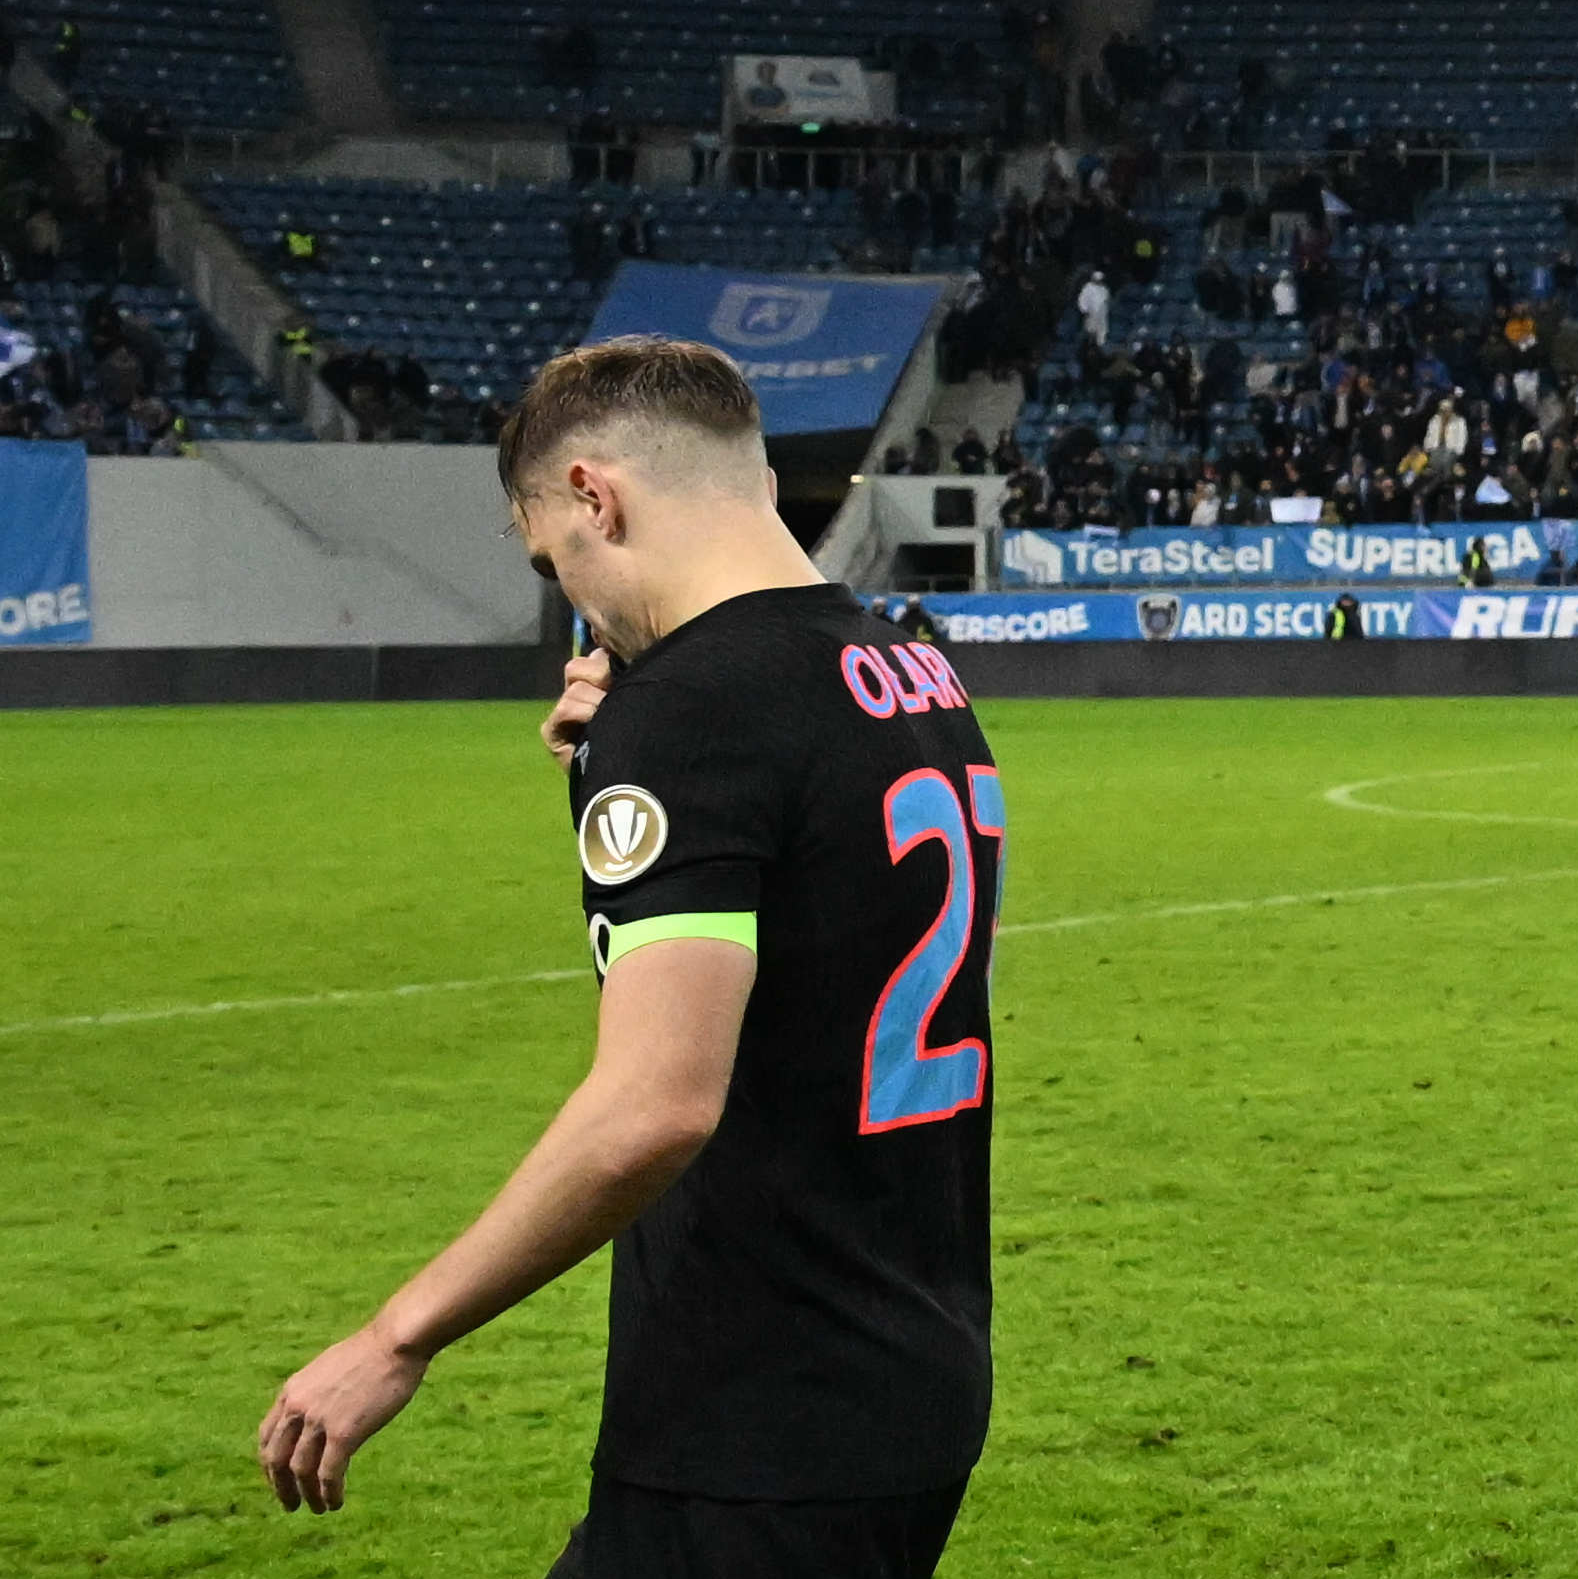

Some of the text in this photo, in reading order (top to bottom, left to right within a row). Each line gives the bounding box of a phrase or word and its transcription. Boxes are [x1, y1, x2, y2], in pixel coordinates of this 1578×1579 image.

[1068, 537, 1274, 574] TeraSteel
[1306, 525, 1540, 575] SUPERLGA
[841, 642, 968, 719] OLAR
